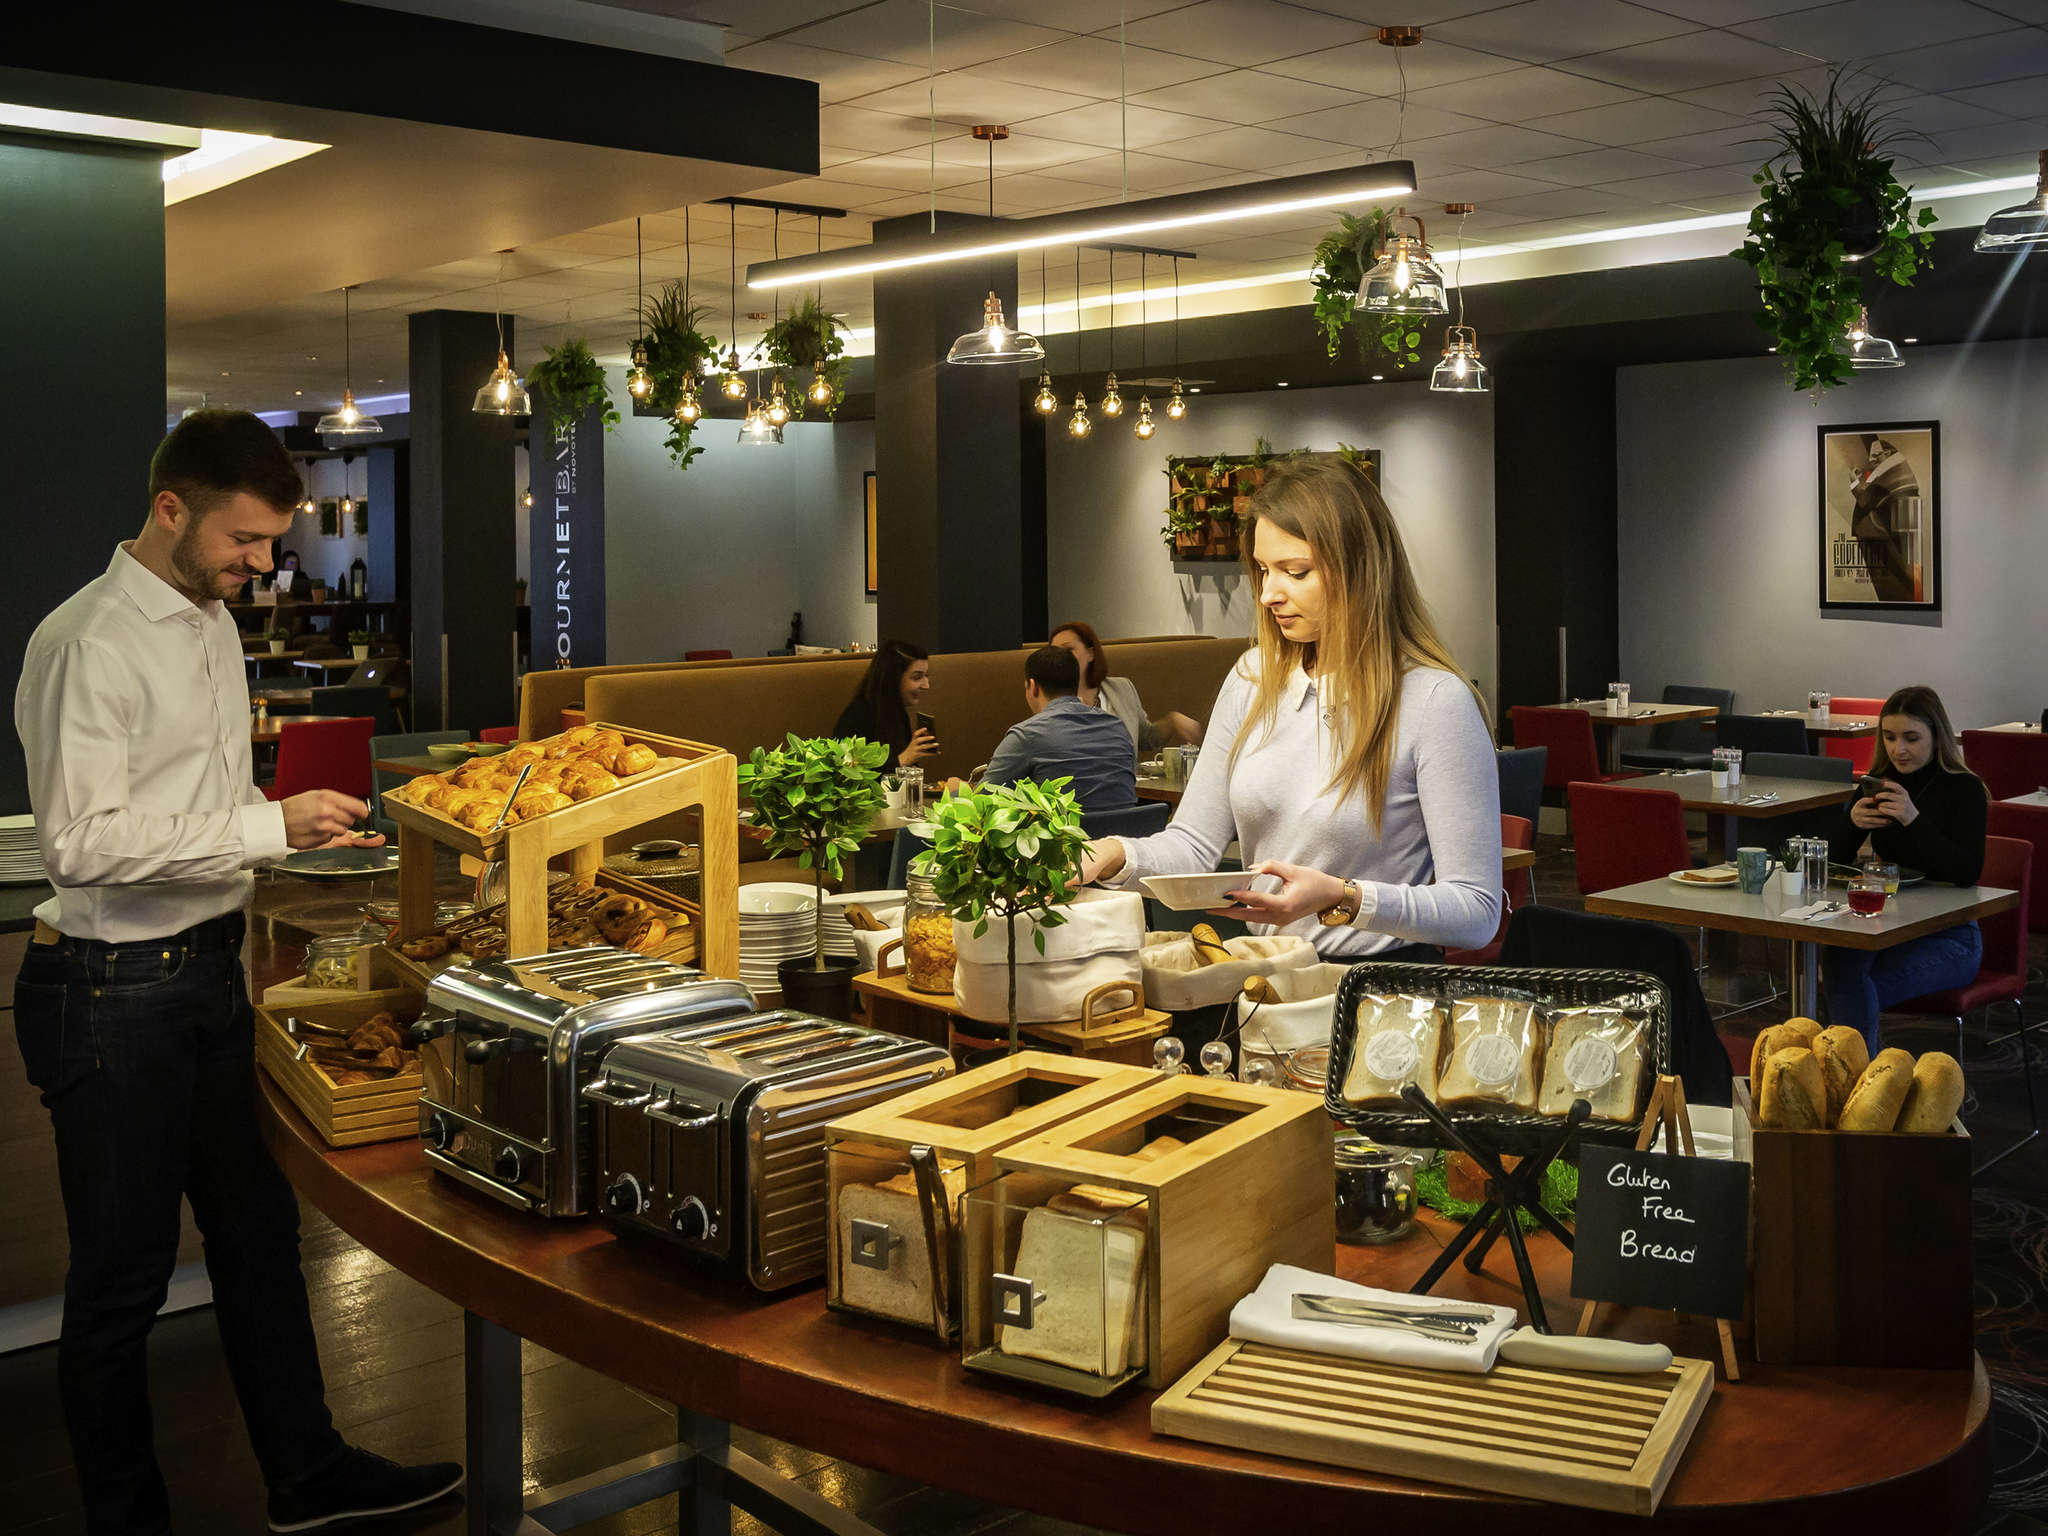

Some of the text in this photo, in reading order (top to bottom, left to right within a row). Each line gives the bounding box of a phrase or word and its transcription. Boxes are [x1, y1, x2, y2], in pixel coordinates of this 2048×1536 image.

[1607, 1163, 1670, 1190] Gluten
[1642, 1196, 1695, 1223] Free
[1620, 1229, 1697, 1263] Bread
